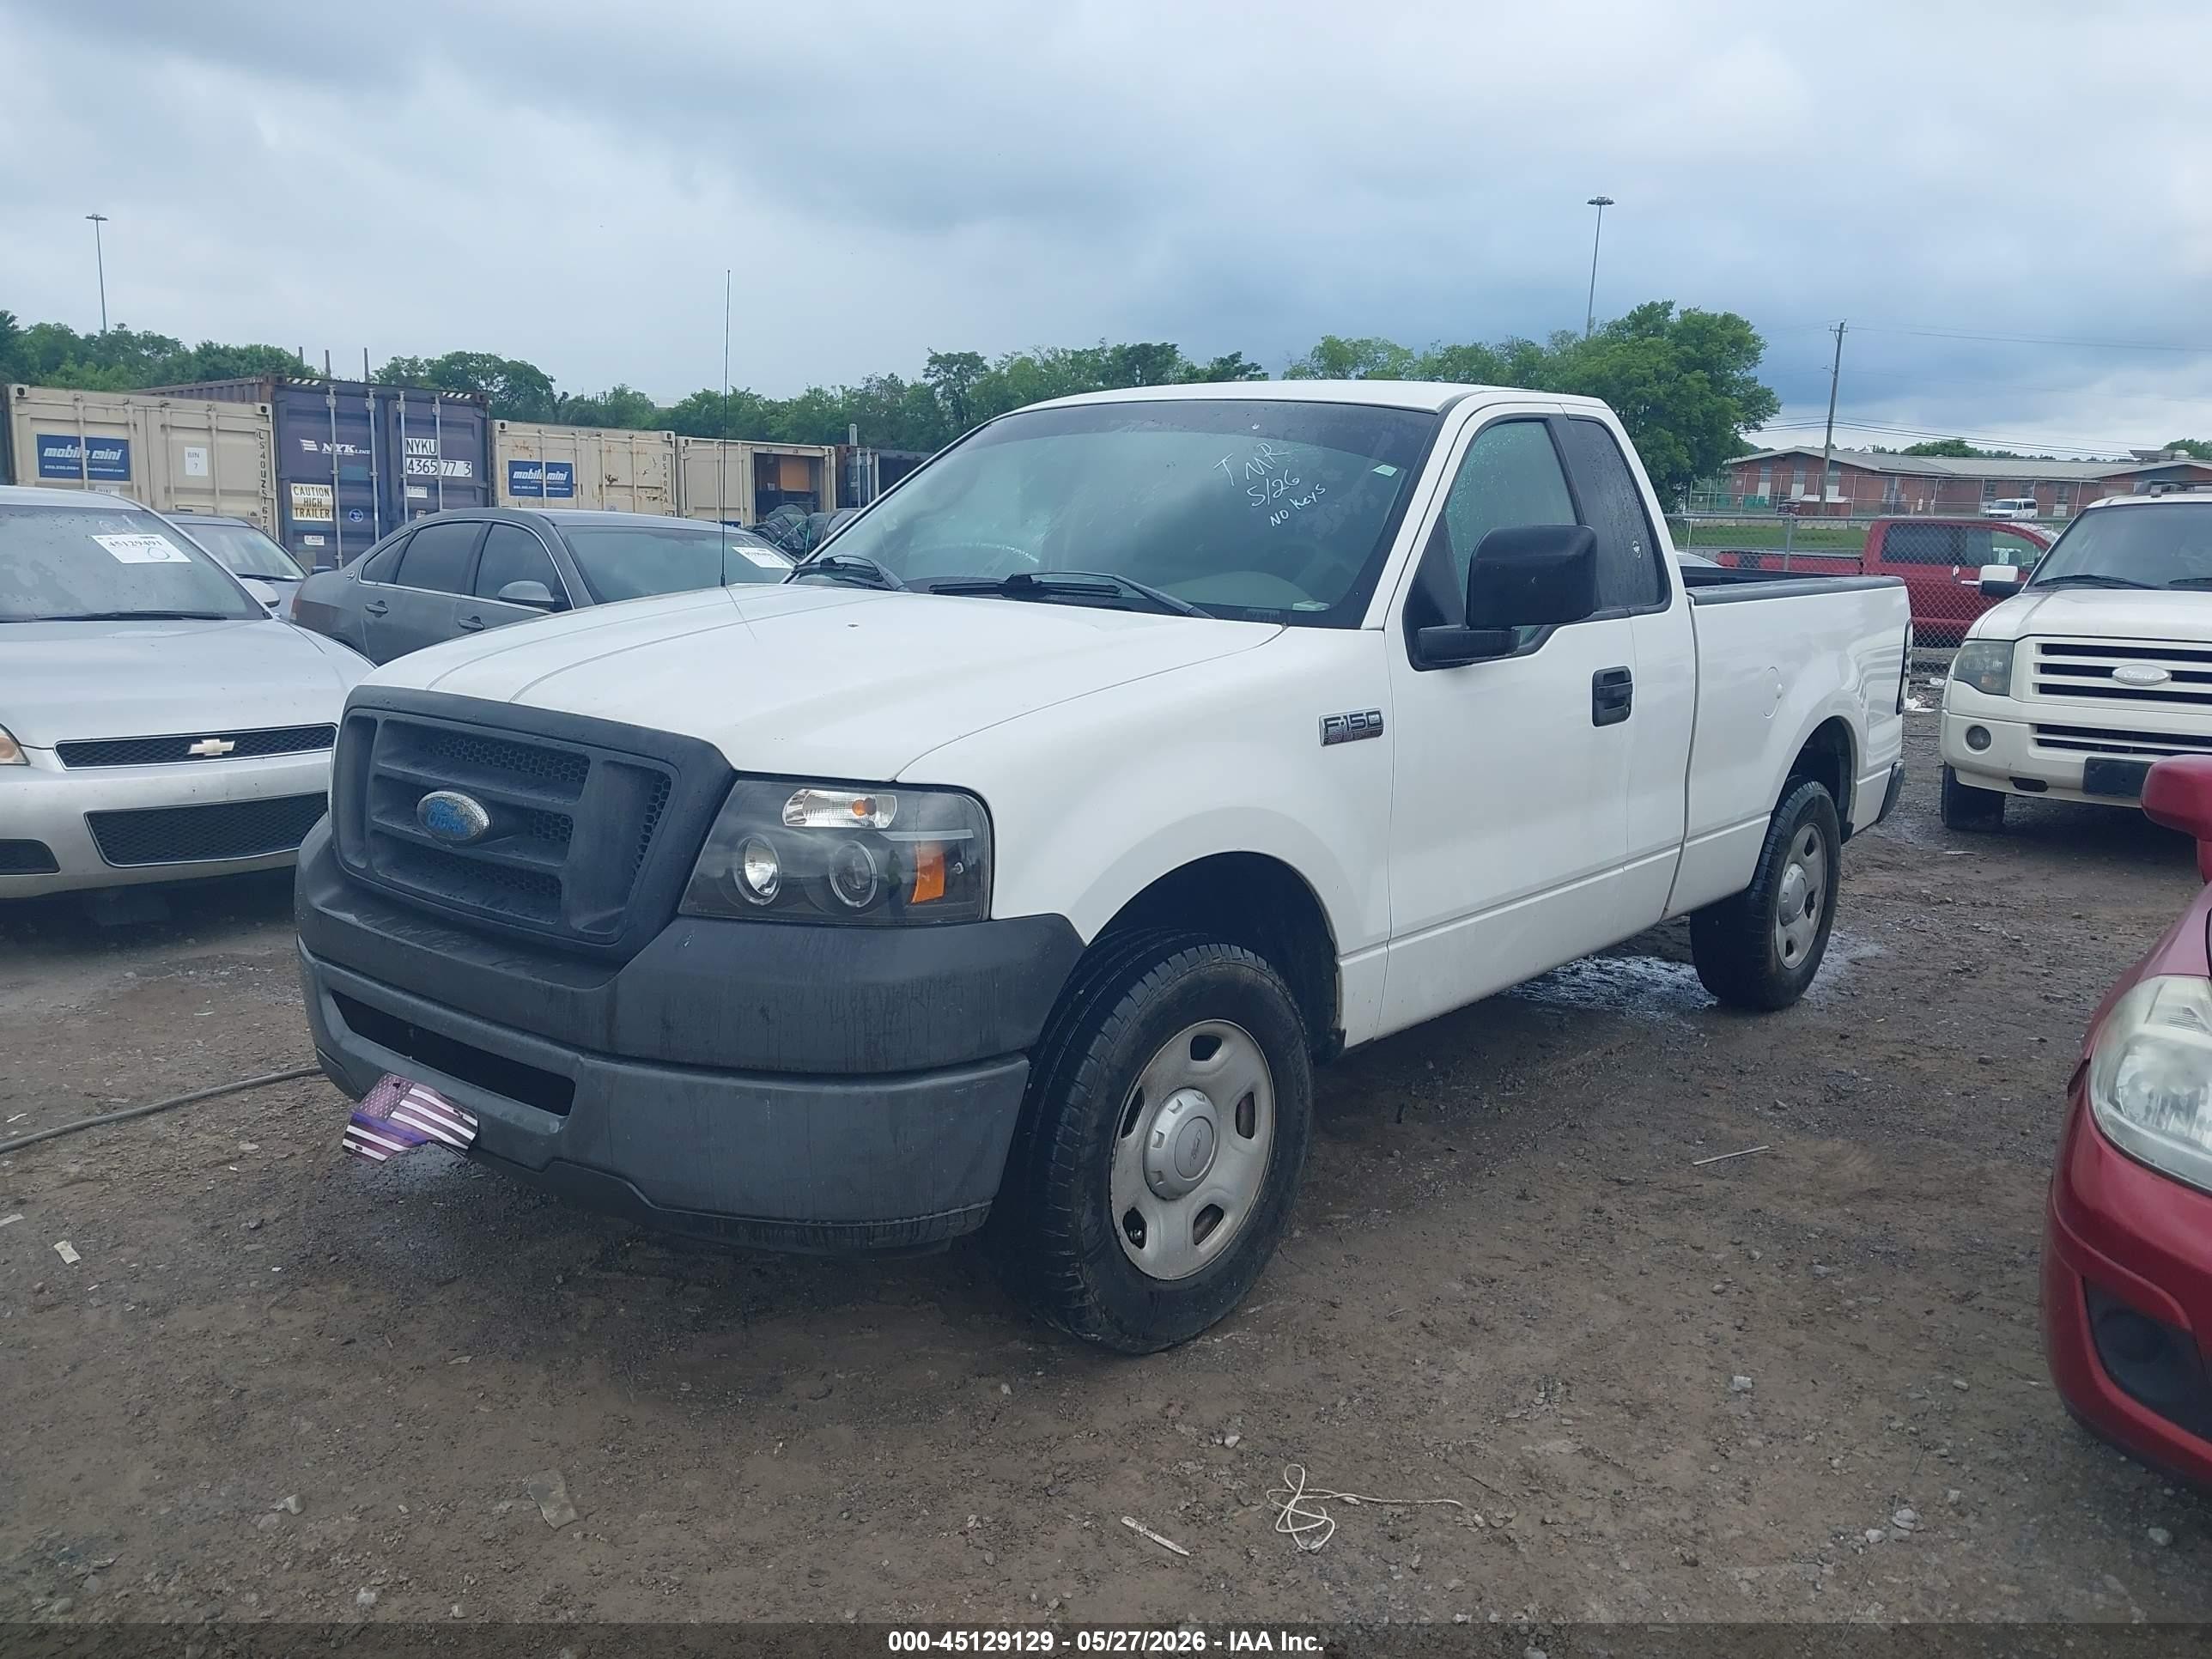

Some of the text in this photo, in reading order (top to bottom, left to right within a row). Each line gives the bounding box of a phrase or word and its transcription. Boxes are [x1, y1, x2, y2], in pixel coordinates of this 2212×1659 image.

[321, 442, 356, 455] NYK
[405, 439, 437, 454] NYKU
[91, 447, 125, 461] mini
[464, 462, 472, 476] 3
[546, 471, 568, 481] mini
[294, 486, 331, 497] CAUTION
[303, 497, 323, 508] HIGH
[295, 507, 331, 520] TRAILER
[1270, 509, 1289, 526] NO
